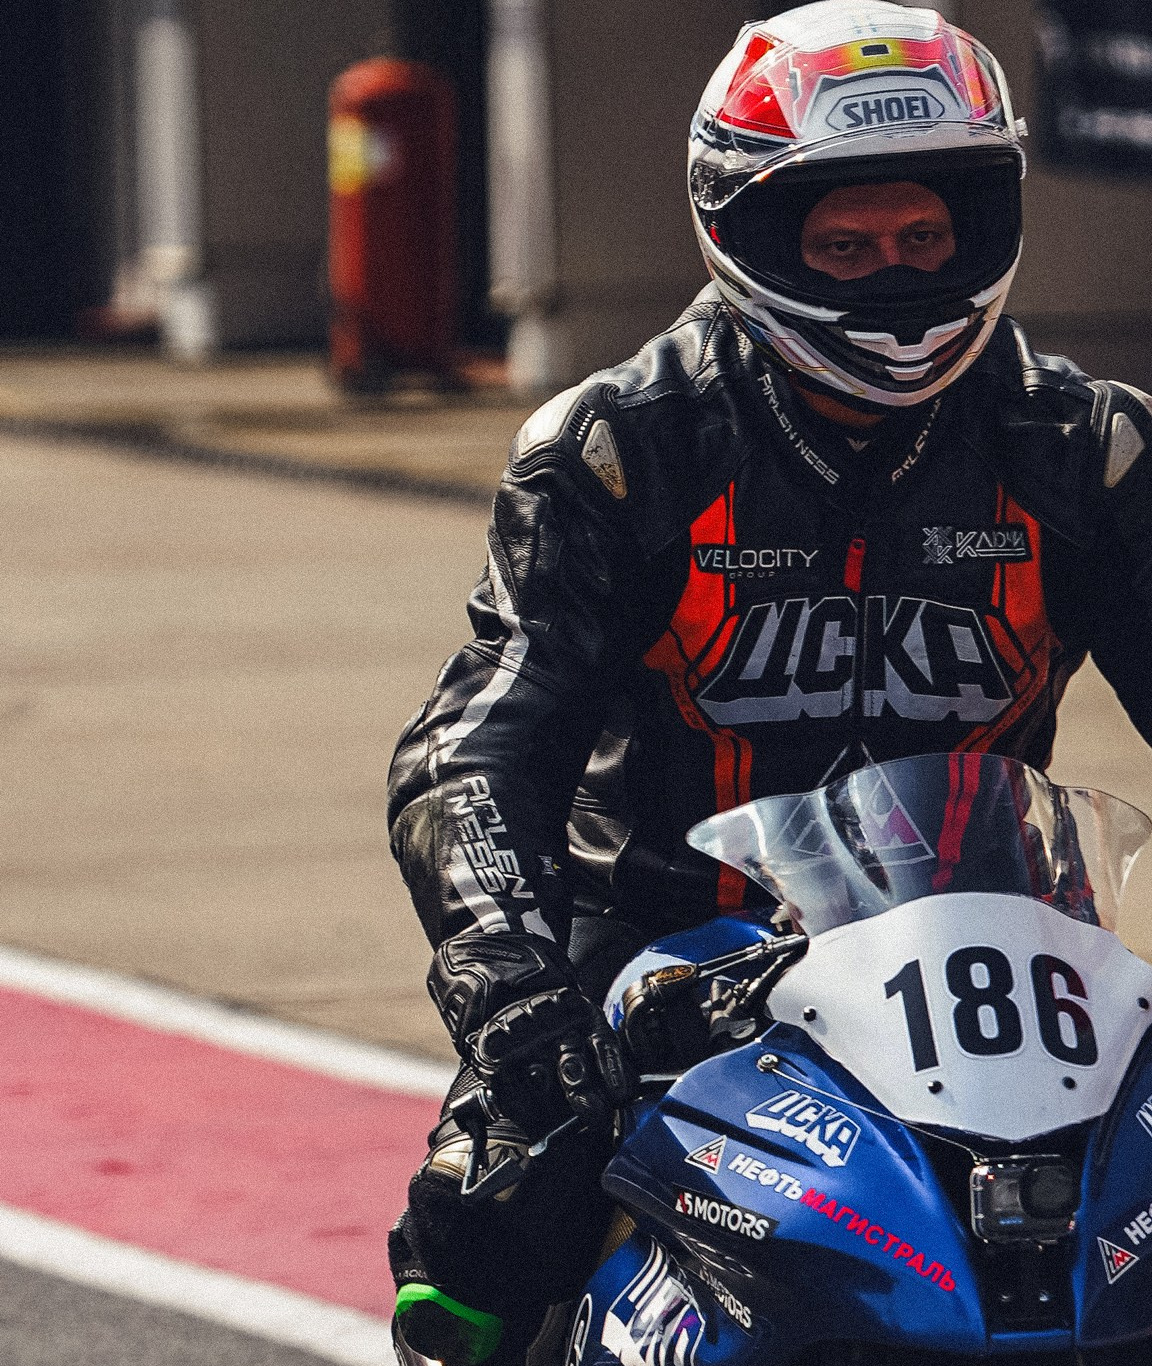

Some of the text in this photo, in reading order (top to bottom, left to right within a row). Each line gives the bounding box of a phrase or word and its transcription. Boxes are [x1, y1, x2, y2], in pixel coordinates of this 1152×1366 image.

[842, 96, 930, 129] SHOEI
[795, 438, 840, 485] NESS
[697, 549, 819, 569] VELOCITY
[697, 595, 1013, 725] ЦСКА
[884, 945, 1099, 1073] 186
[745, 1089, 861, 1167] ЦСКА
[694, 1196, 770, 1240] MOTORS
